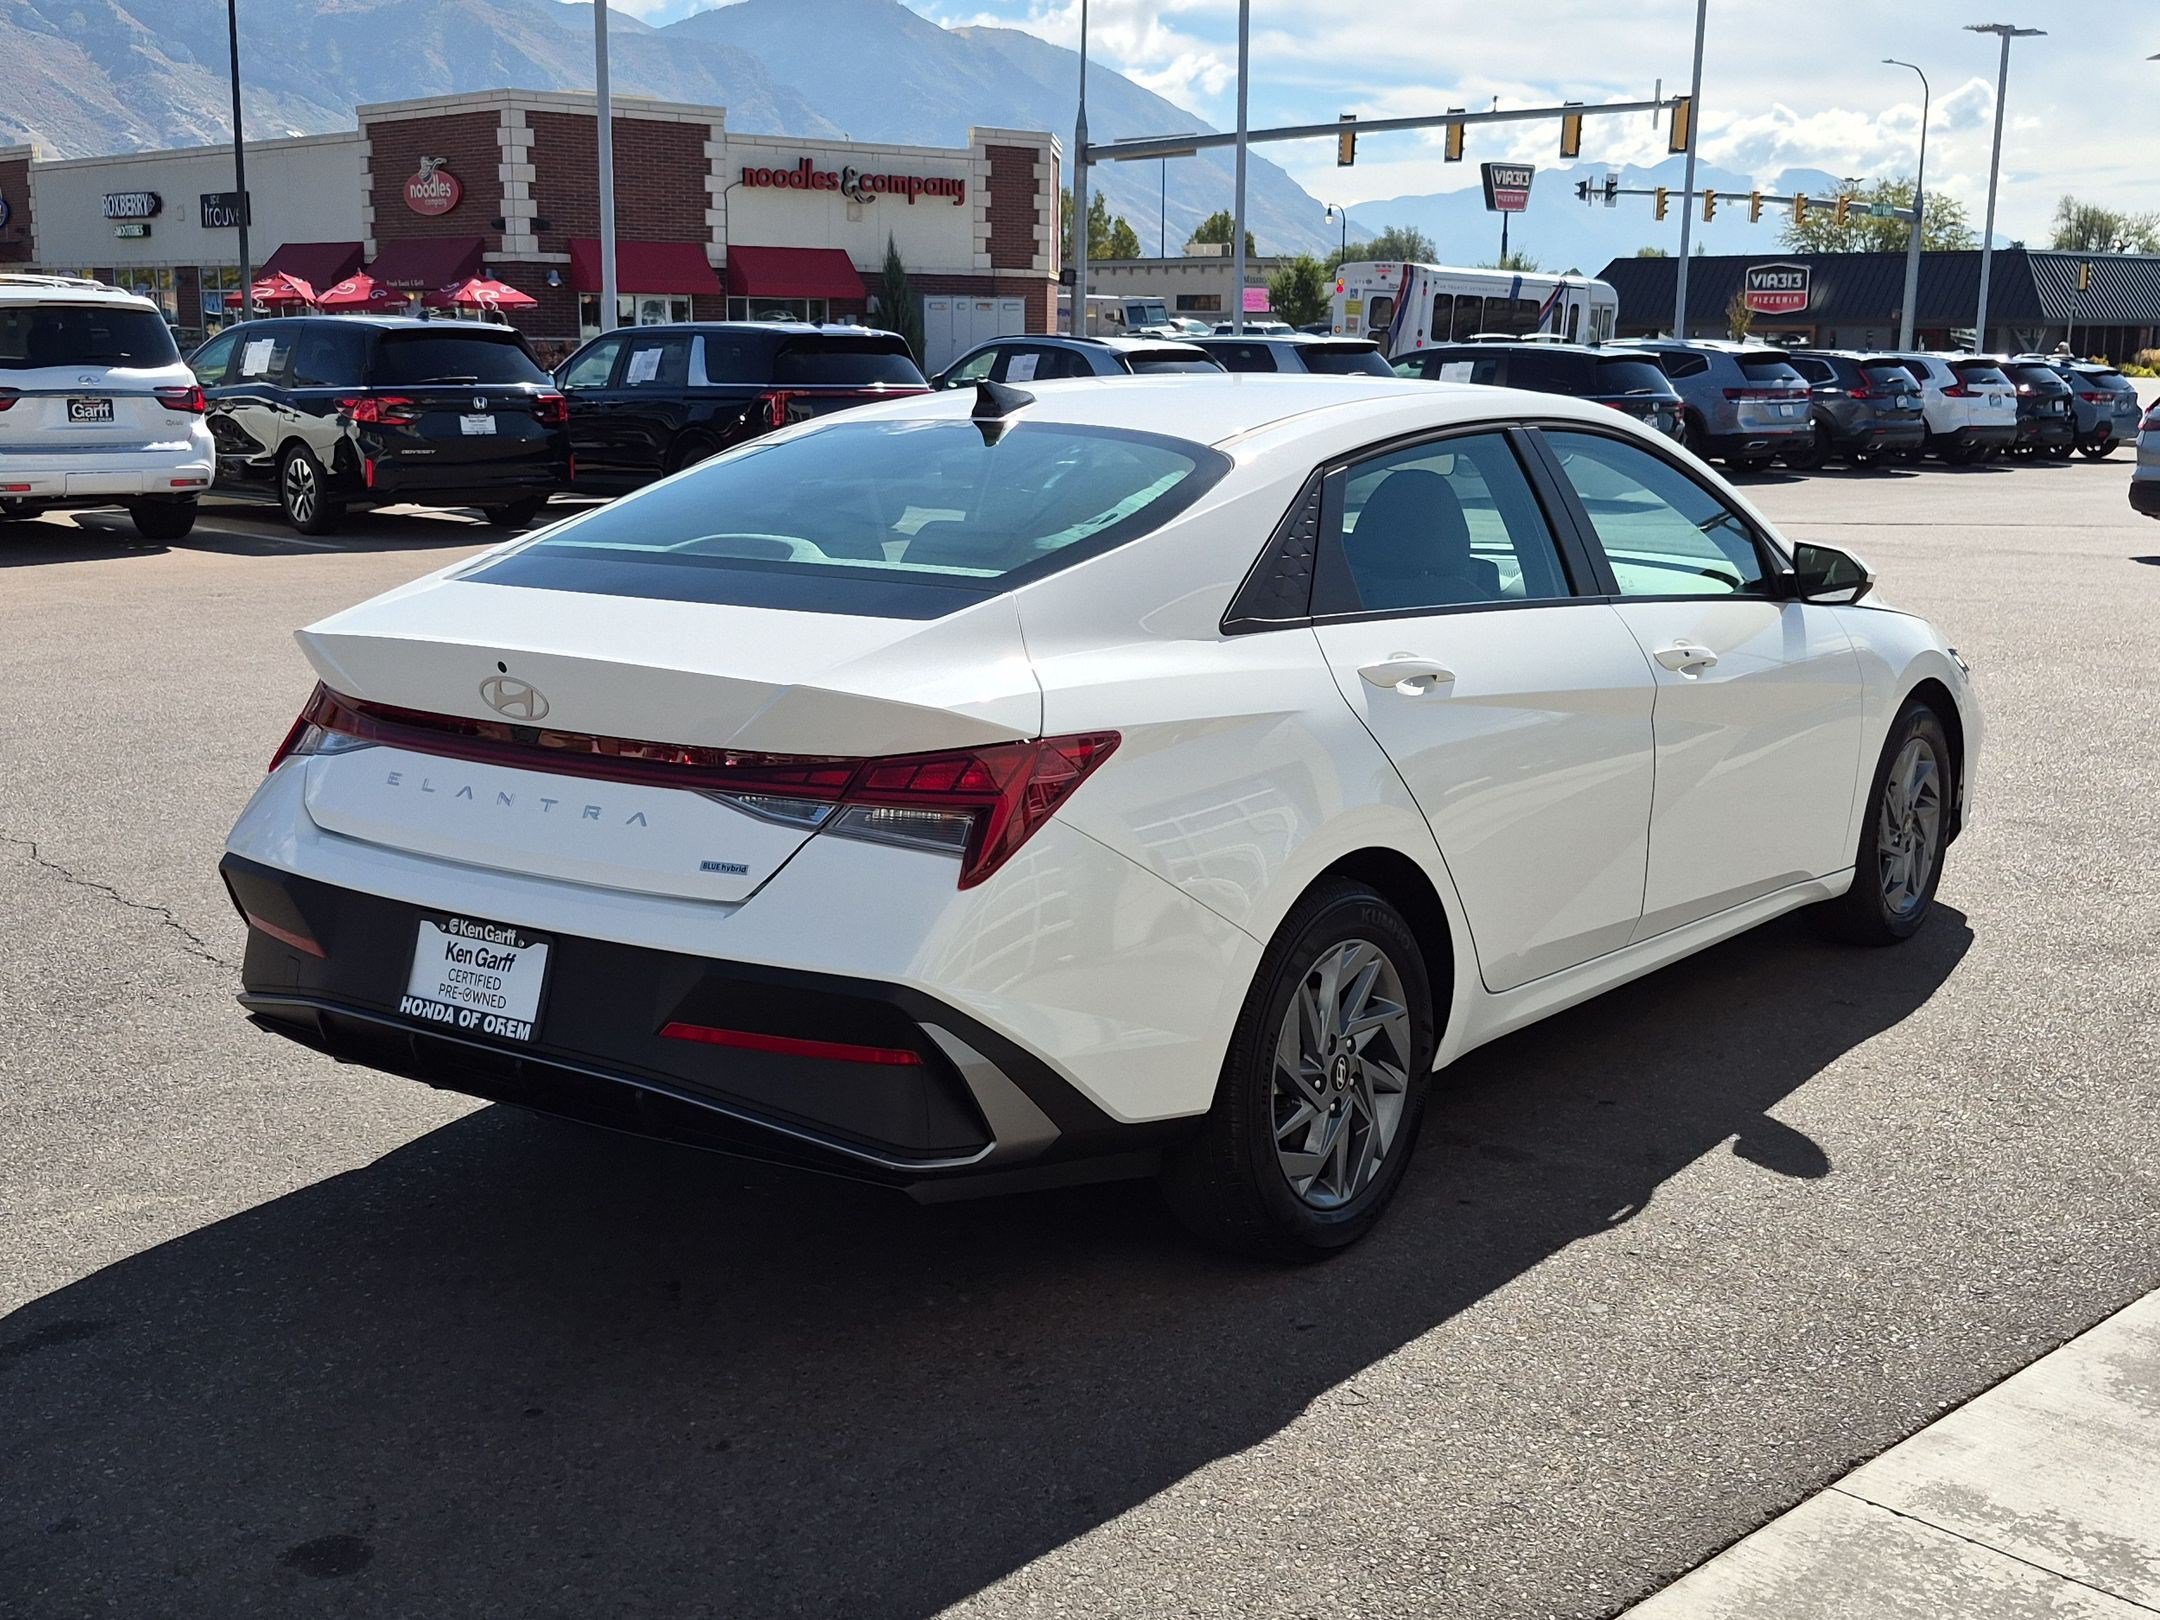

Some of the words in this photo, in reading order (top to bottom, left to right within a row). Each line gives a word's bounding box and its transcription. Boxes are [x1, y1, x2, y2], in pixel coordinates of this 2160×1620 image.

[409, 173, 452, 199] noodles
[741, 156, 840, 191] noodles
[841, 165, 876, 204] &
[858, 172, 966, 206] company
[102, 193, 149, 217] ROXBERRY
[113, 224, 144, 237] SMOOTHIES
[1750, 273, 1802, 289] VIA313
[71, 403, 110, 418] Garff
[385, 770, 649, 828] ELANTRA
[459, 920, 484, 940] Ken
[483, 924, 518, 946] Garff
[445, 940, 473, 965] Ken
[474, 947, 517, 973] Garff
[448, 968, 502, 991] CERTIFIED
[400, 995, 454, 1024] HONDA
[458, 1009, 482, 1030] OF
[483, 1016, 532, 1041] OREM
